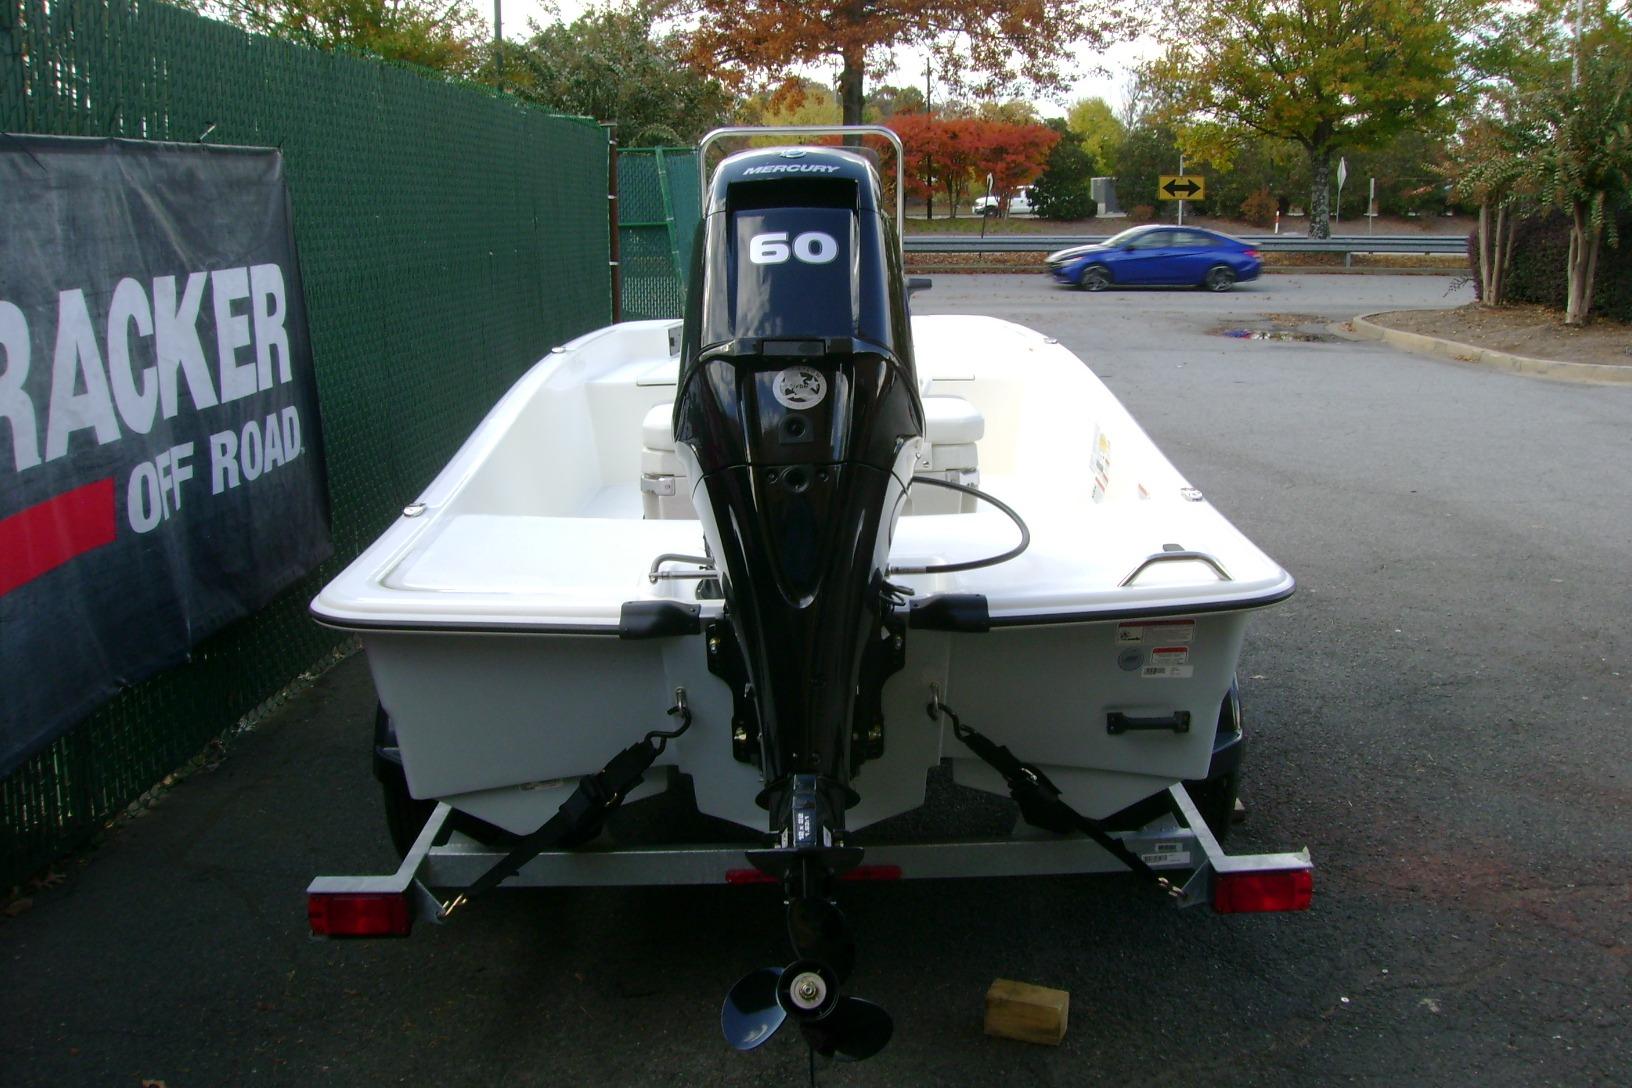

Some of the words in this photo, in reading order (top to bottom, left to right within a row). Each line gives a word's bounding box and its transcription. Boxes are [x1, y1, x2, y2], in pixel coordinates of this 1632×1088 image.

[742, 164, 840, 176] MERCURY
[750, 231, 838, 264] 60
[128, 442, 194, 534] OFF
[210, 405, 301, 495] ROAD
